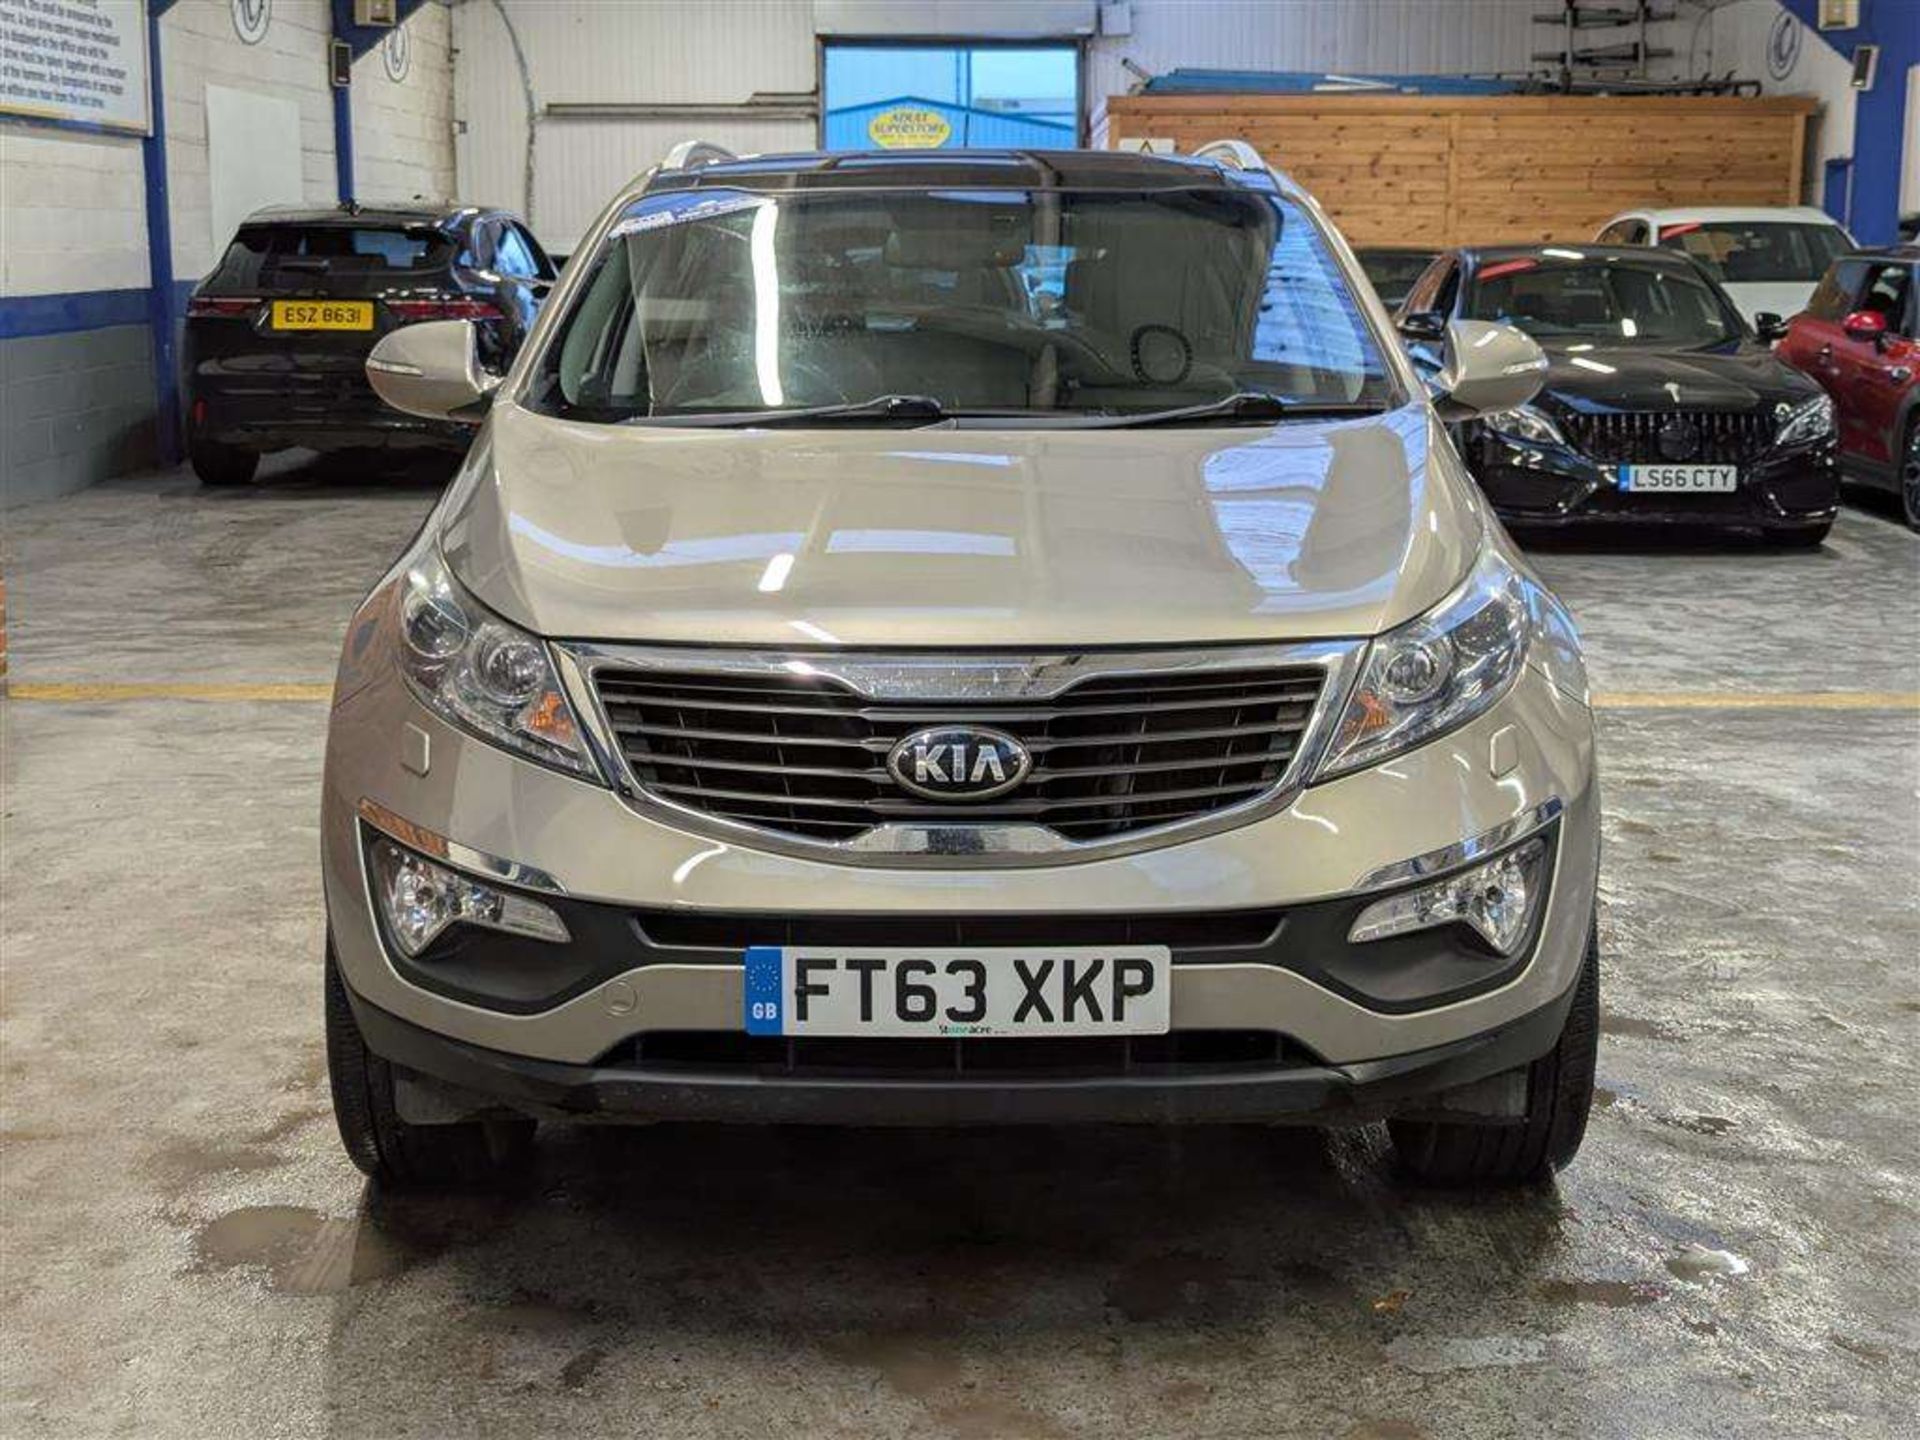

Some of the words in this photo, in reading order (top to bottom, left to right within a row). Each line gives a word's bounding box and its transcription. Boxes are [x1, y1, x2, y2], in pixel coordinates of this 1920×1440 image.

[284, 307, 318, 323] ESZ
[1634, 469, 1687, 487] LS66
[1693, 469, 1731, 487] CTY
[913, 744, 1006, 782] KIA
[794, 958, 987, 1022] FT63
[1012, 958, 1154, 1022] XKP
[753, 1002, 777, 1019] GB
